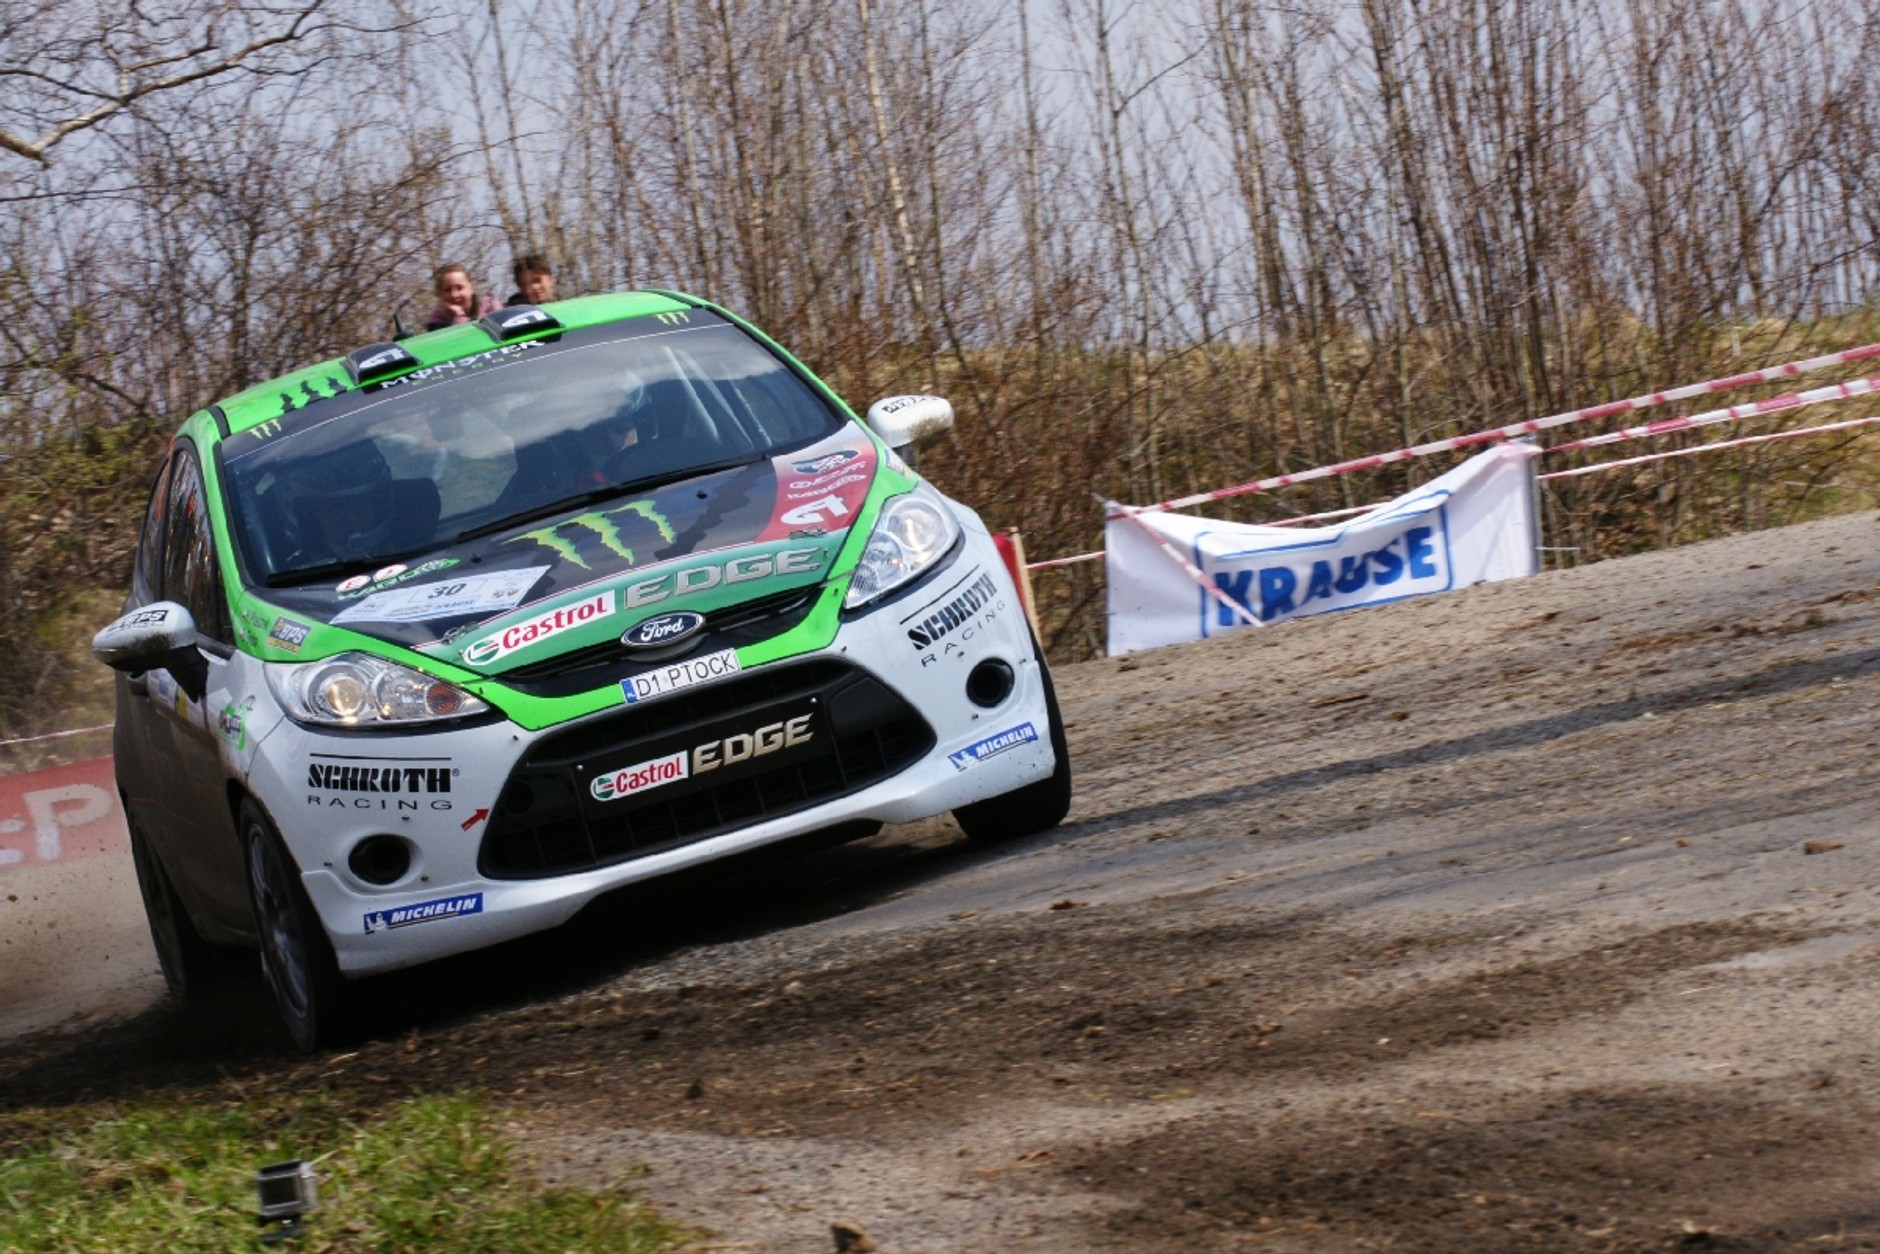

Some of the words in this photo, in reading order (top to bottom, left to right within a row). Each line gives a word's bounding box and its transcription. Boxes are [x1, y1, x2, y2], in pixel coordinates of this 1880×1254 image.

[380, 340, 545, 388] MONSTER
[428, 583, 467, 599] 30
[1213, 526, 1438, 627] KRAUSE
[501, 596, 607, 650] Castrol
[624, 547, 821, 609] EDGE
[907, 571, 998, 650] SCHROTH
[278, 622, 308, 644] BPS
[640, 618, 685, 642] Ford
[921, 599, 1006, 668] RACING
[636, 674, 660, 697] D1
[668, 652, 735, 687] PTOCK
[615, 756, 682, 794] Castrol
[693, 712, 814, 775] EDGE
[974, 725, 1035, 758] MICHELIN
[308, 763, 452, 793] SCHROTH
[308, 795, 452, 810] RACING
[390, 898, 477, 923] MICHELIN
